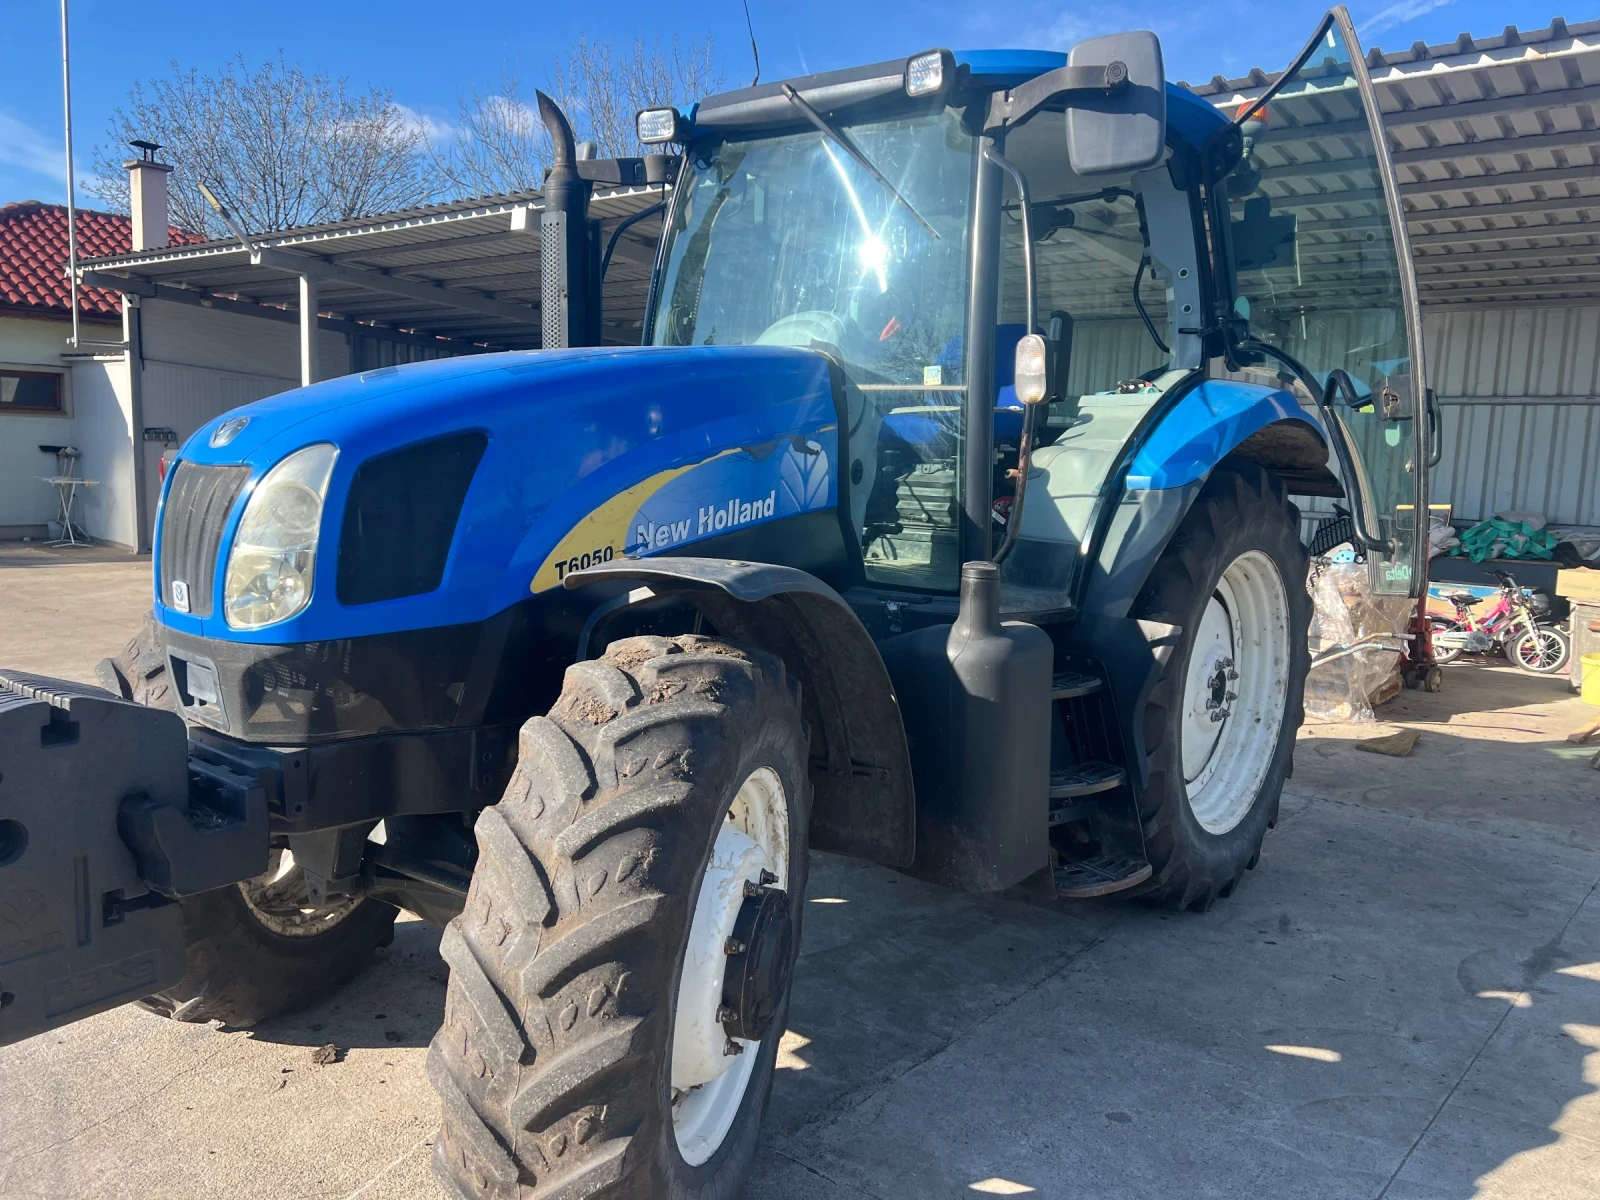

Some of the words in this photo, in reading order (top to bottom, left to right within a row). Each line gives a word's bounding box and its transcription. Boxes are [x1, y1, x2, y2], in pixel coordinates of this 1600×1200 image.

[636, 518, 691, 553] New
[697, 490, 776, 535] Holland
[554, 545, 614, 581] T6050
